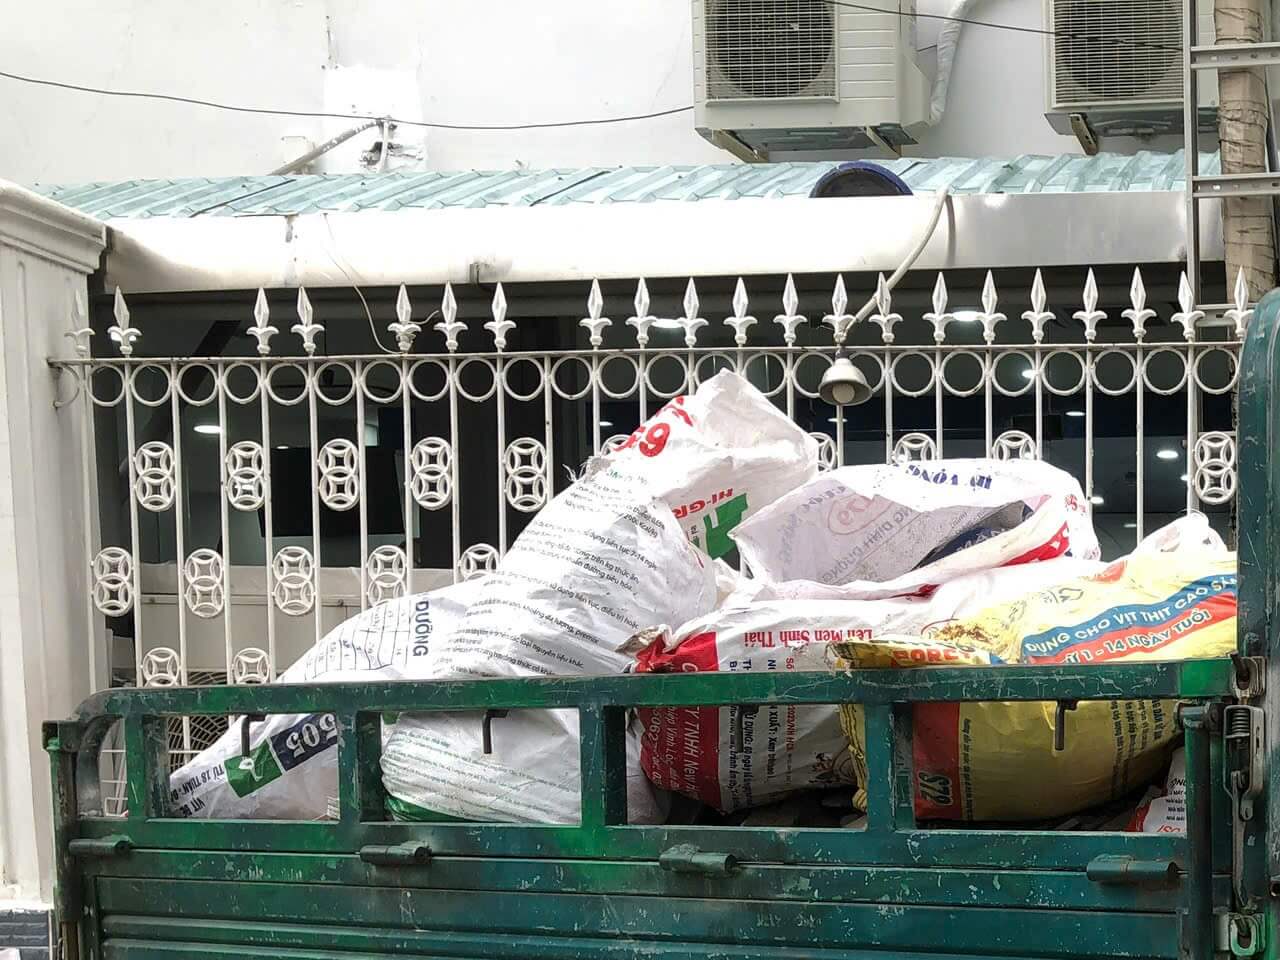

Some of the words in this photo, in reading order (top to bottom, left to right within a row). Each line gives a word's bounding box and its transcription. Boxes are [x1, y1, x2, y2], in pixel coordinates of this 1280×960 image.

[1073, 620, 1111, 641] CHO
[1113, 610, 1138, 630] VỊT
[1140, 606, 1171, 624] THỊT
[1173, 586, 1208, 613] CAO
[744, 631, 775, 648] Thái
[780, 631, 810, 648] Sinh
[816, 630, 843, 647] Men
[1104, 637, 1125, 653] 14
[1126, 628, 1171, 649] NGÀY
[1172, 607, 1210, 633] TUỔI
[286, 713, 338, 757] 505
